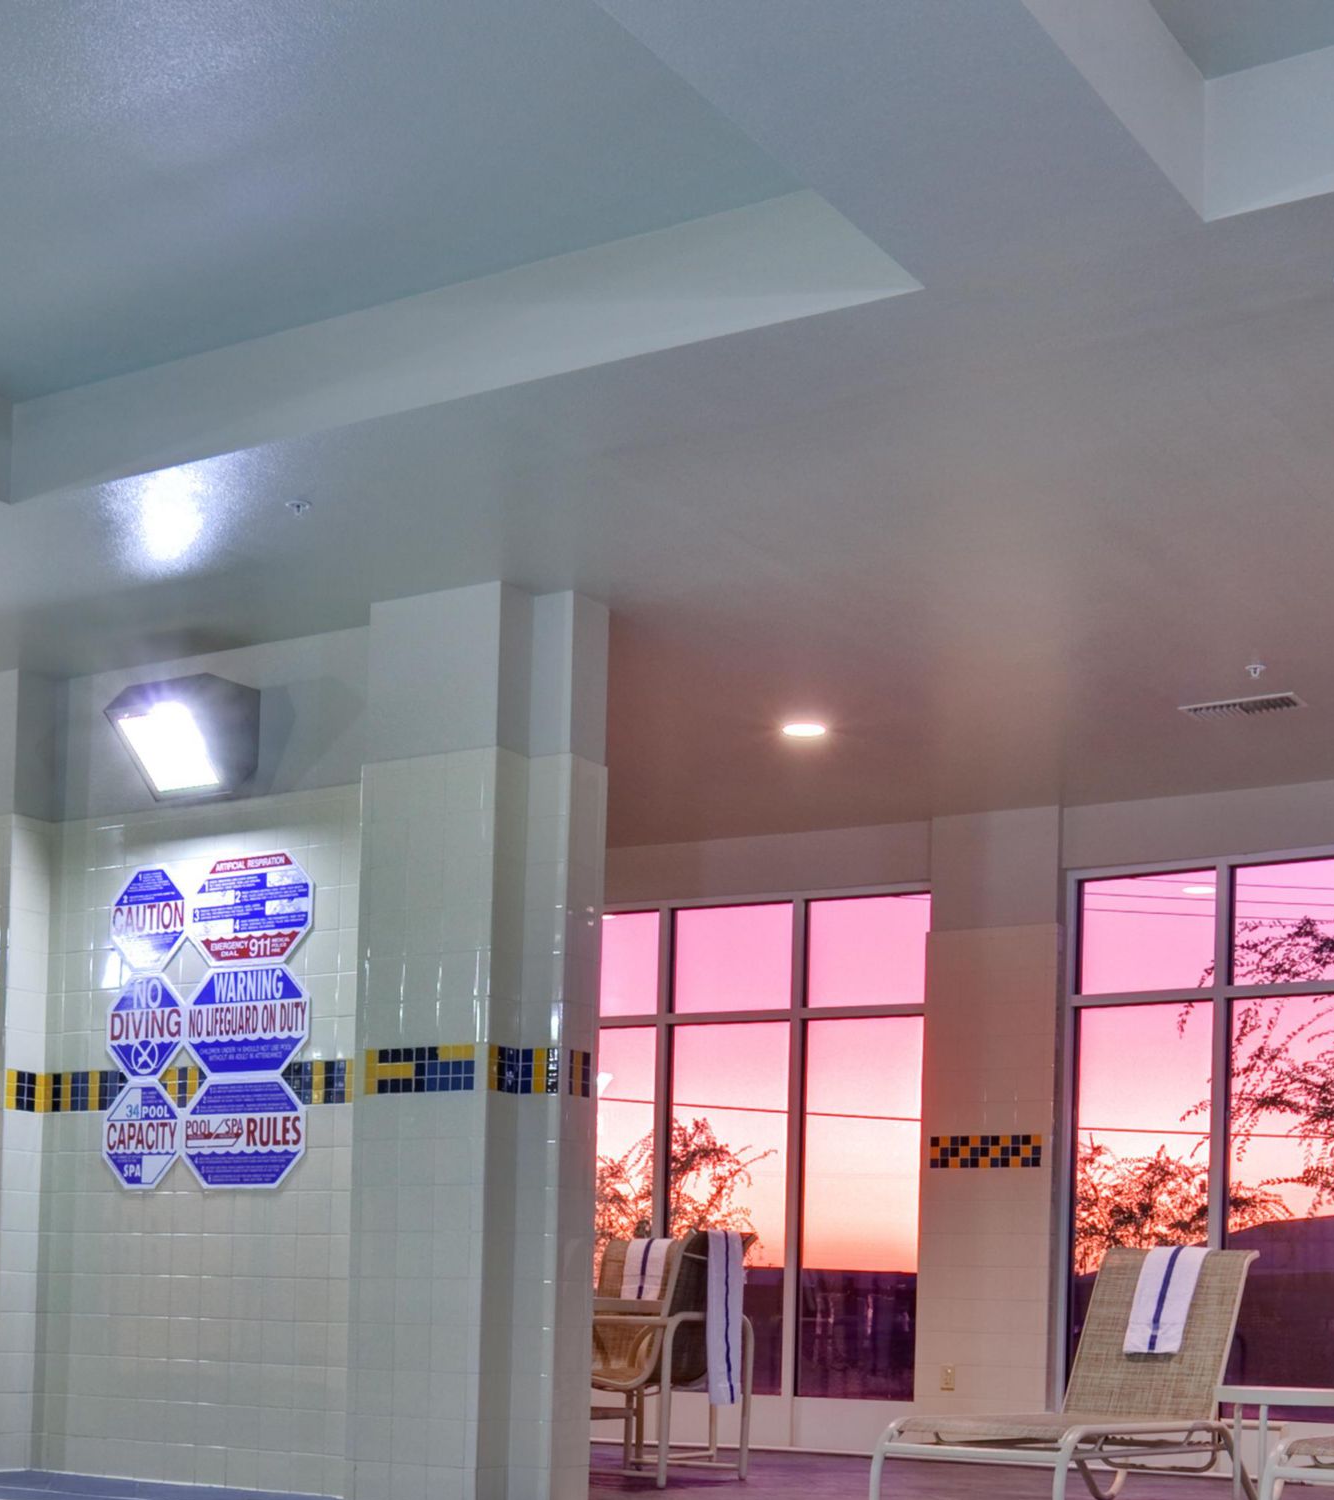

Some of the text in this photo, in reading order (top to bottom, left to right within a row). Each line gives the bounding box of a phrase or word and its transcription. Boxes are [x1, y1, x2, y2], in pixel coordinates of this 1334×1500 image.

[215, 855, 285, 872] ARTIFICIAL RESPIRATION
[234, 891, 242, 903] 2
[113, 901, 185, 935] CAUTION
[194, 909, 200, 921] 3
[210, 940, 248, 951] EMERGENCY
[249, 937, 271, 957] 911
[133, 979, 163, 1009] NO
[213, 968, 284, 1003] WARNING
[110, 1008, 182, 1041] DIVING
[188, 1001, 307, 1038] NO LIFEGUARD ON DUTY
[126, 1103, 170, 1118] 34 POOL
[107, 1121, 177, 1151] CAPACITY
[186, 1116, 302, 1147] POOL SPA RULES
[123, 1164, 141, 1178] SPA
